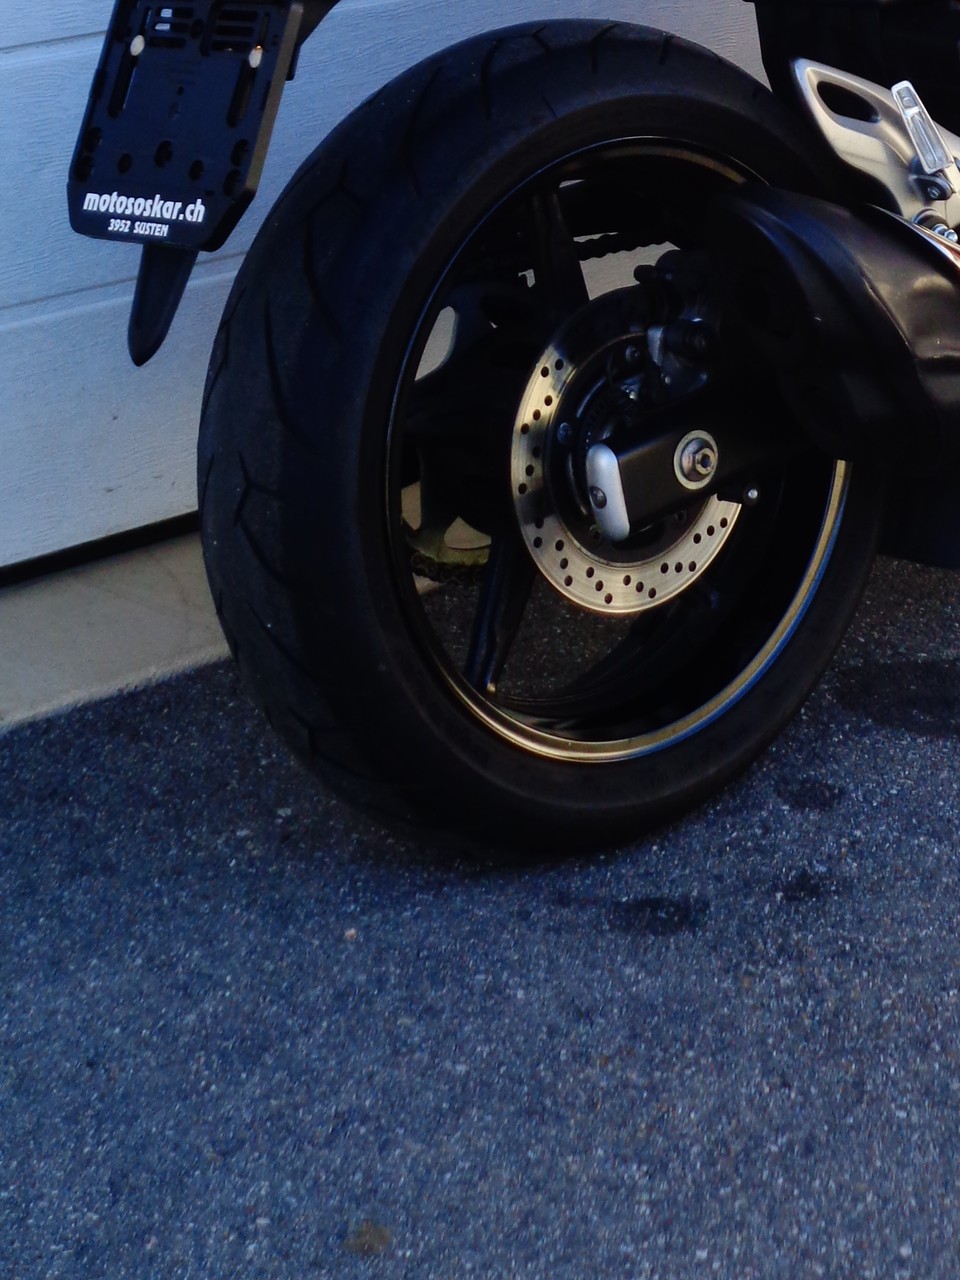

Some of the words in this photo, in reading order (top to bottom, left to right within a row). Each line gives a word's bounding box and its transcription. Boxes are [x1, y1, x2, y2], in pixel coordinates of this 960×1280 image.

[83, 191, 206, 222] motososkar.ch
[108, 218, 131, 233] 3952
[133, 221, 169, 236] SUSTEN
